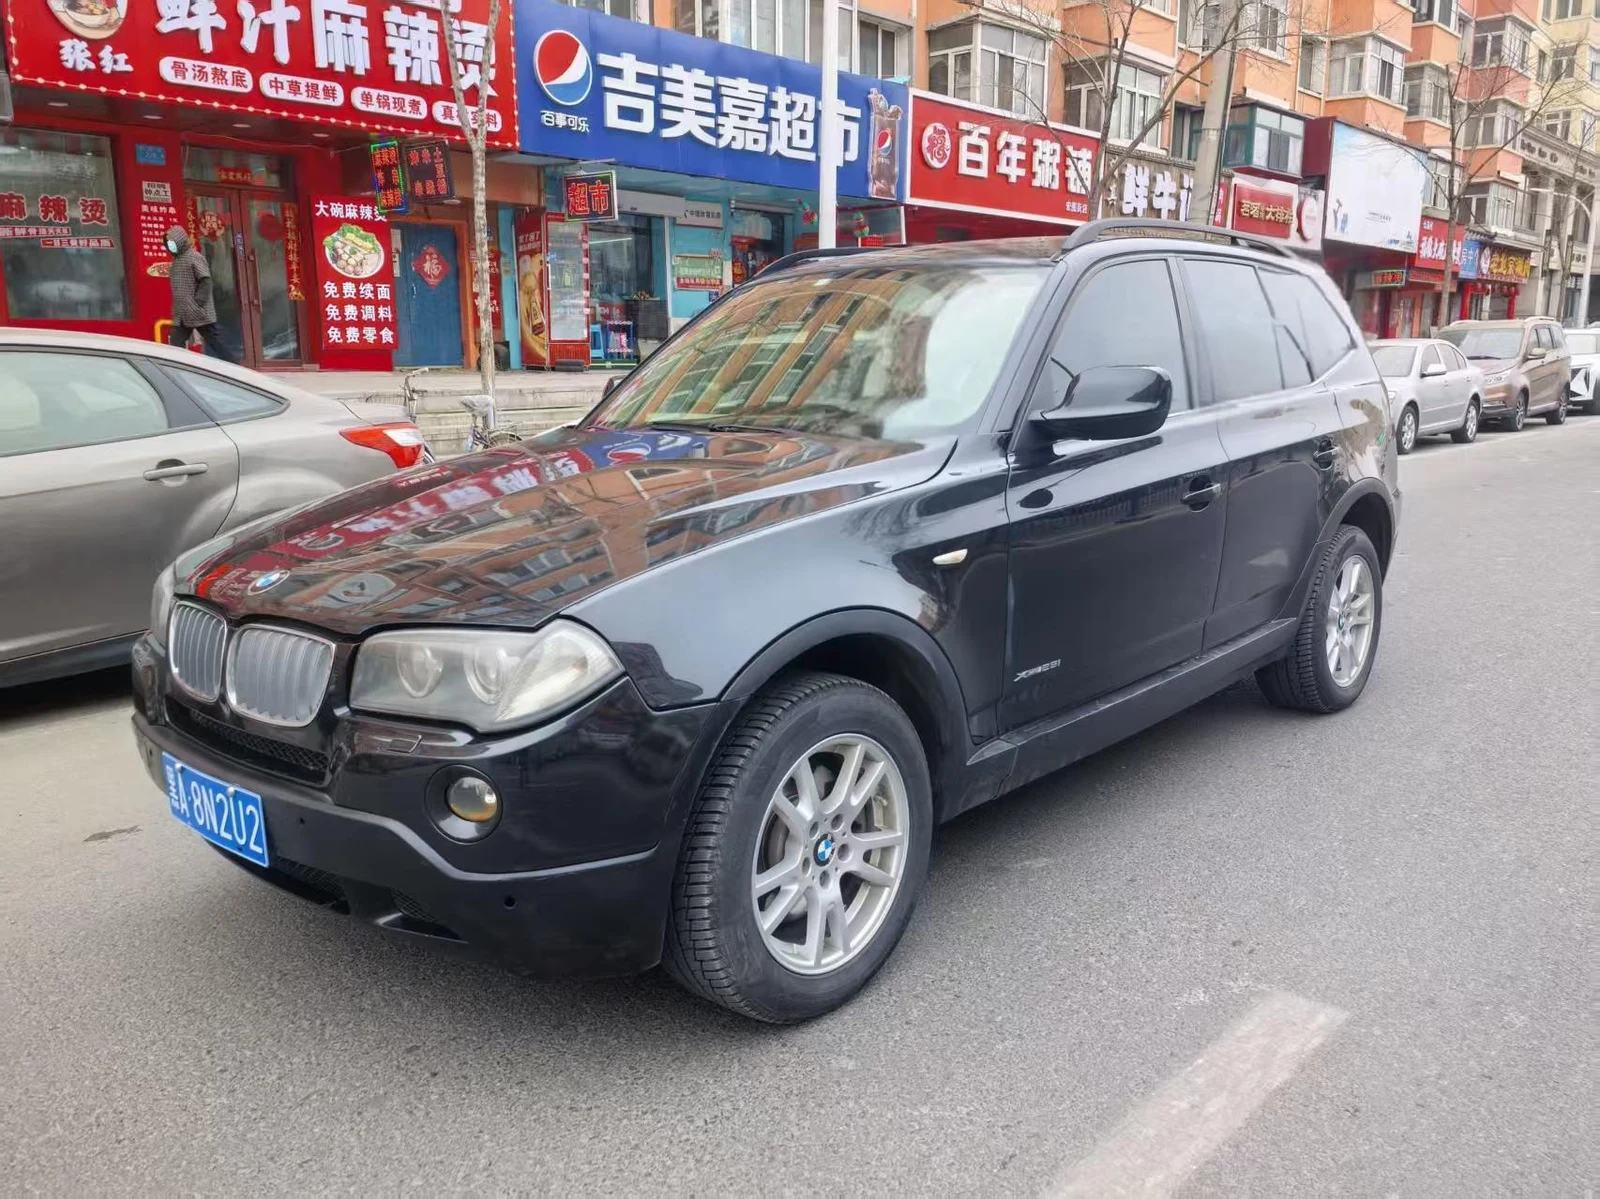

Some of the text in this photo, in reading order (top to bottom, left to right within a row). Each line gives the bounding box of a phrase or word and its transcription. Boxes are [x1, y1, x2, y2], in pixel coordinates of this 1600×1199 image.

[59, 38, 134, 74] 张红
[171, 60, 248, 88] 骨汤熬底
[269, 77, 338, 105] 中草提鲜
[360, 91, 423, 115] 单锅现煮
[540, 110, 590, 133] 百事可乐
[596, 51, 862, 167] 吉美嘉超市
[957, 121, 1093, 195] 百年粥铺
[567, 180, 609, 215] 超市
[323, 281, 391, 300] 免费续面
[325, 304, 393, 322] 免费调料
[327, 326, 394, 344] 免费零食
